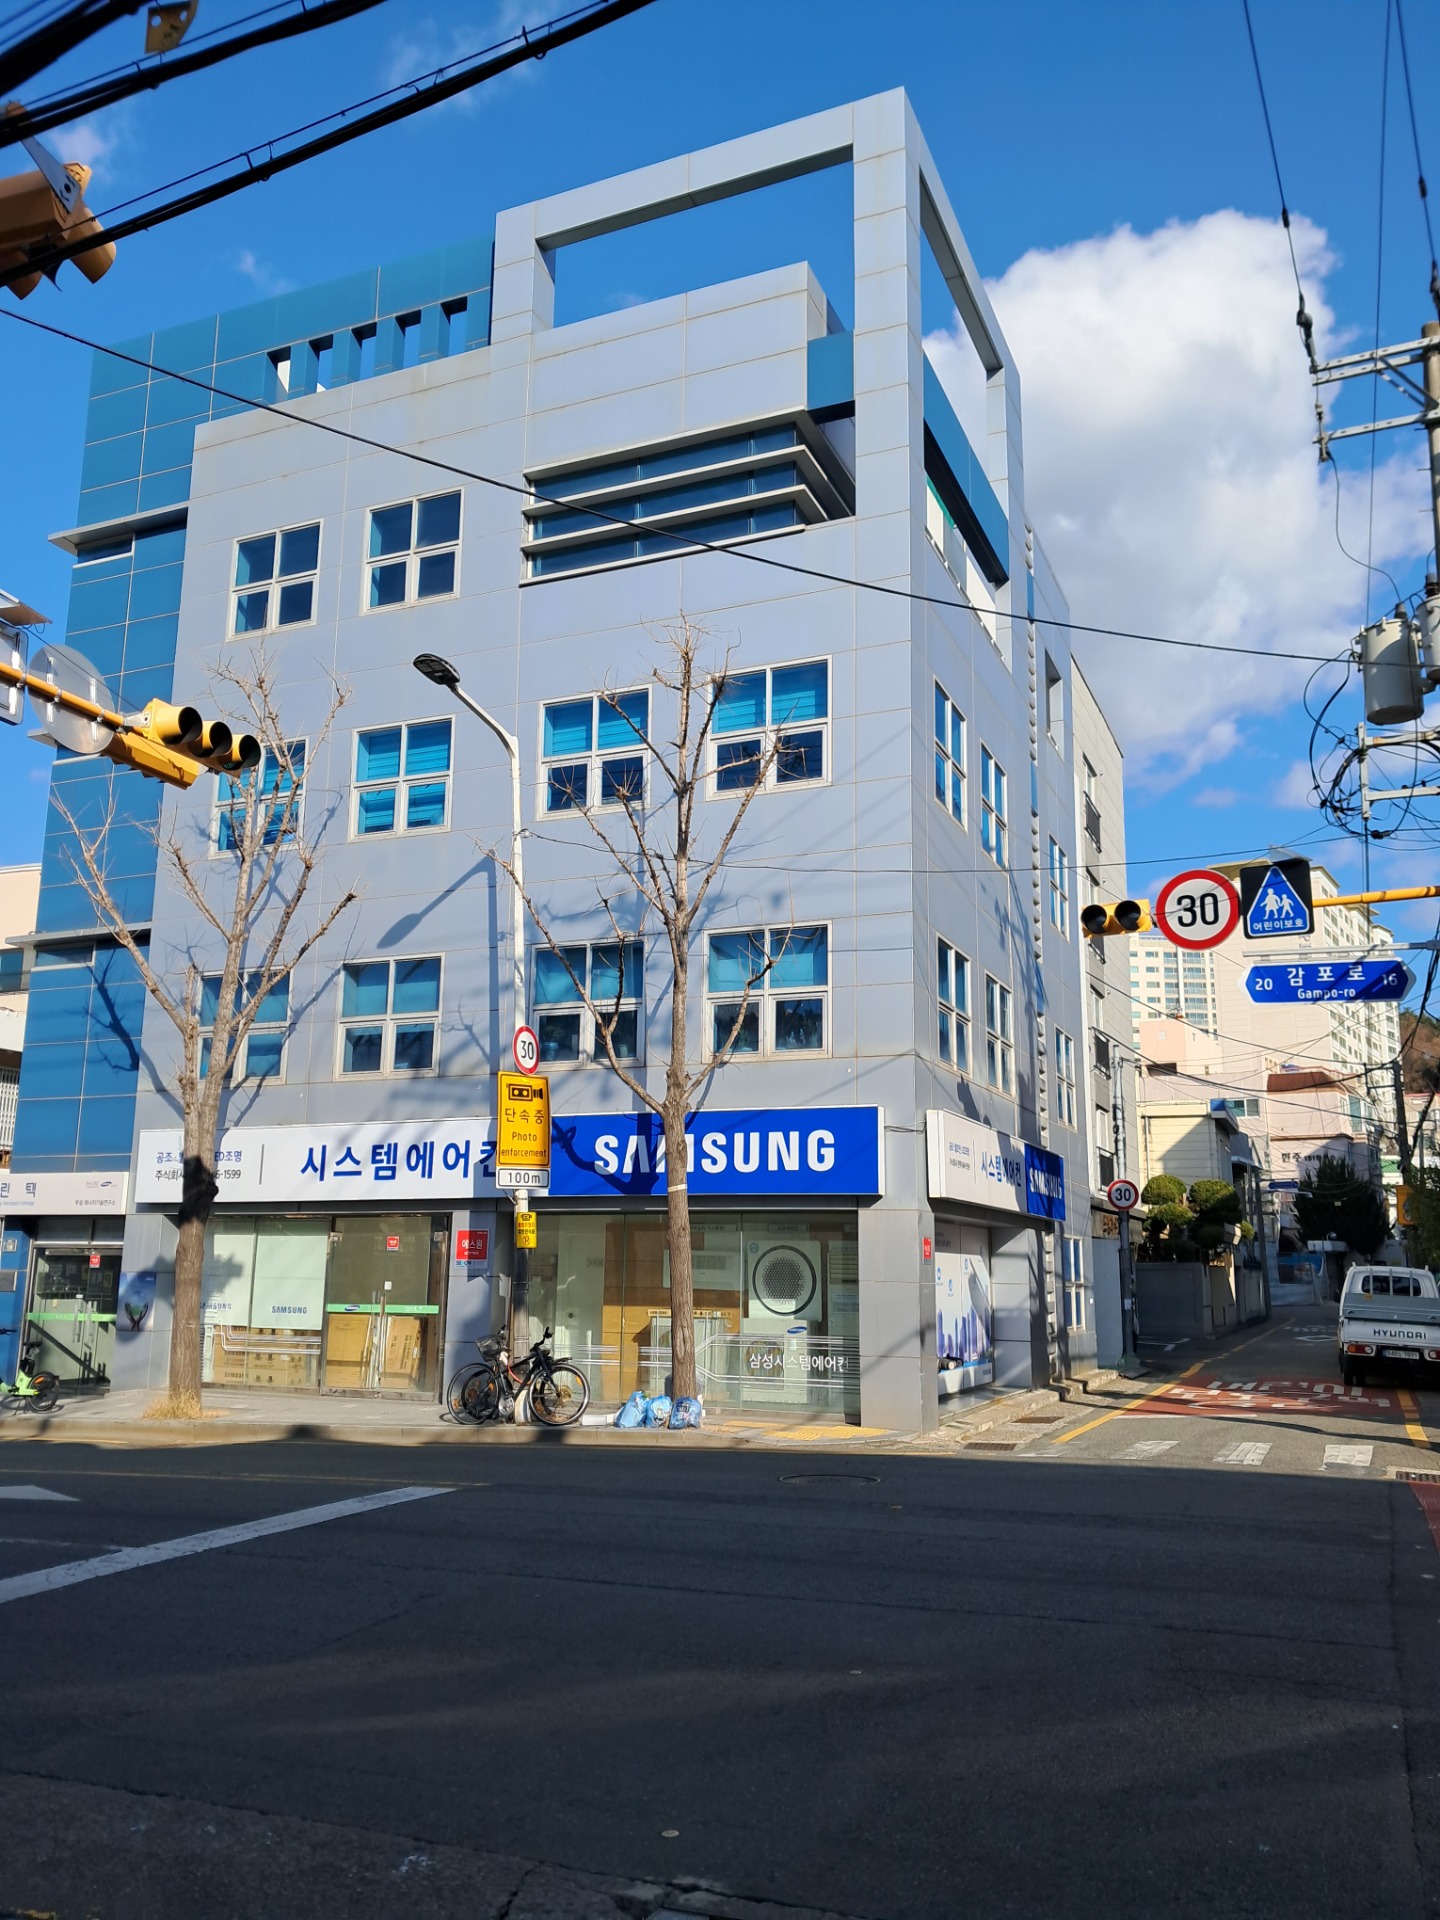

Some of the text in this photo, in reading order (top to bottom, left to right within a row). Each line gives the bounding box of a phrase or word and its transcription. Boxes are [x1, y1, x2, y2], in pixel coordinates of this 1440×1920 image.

[1177, 893, 1219, 927] 30
[1253, 919, 1305, 931] 어린이보호
[1255, 978, 1273, 991] 20
[1382, 973, 1398, 987] 16
[1297, 988, 1356, 1000] Gampo-ro
[520, 1040, 534, 1060] 30
[504, 1107, 545, 1126] 단속중
[511, 1131, 537, 1142] Photo
[501, 1148, 547, 1158] enforcement
[507, 1172, 540, 1184] 100m
[1029, 1166, 1063, 1200] SAMSUNG
[1115, 1188, 1131, 1201] 30
[461, 1239, 483, 1250] 에스원
[271, 1305, 308, 1315] SAMSUNG
[1373, 1329, 1427, 1340] HYUNDAI
[749, 1353, 849, 1372] 삼성시스템에어컨
